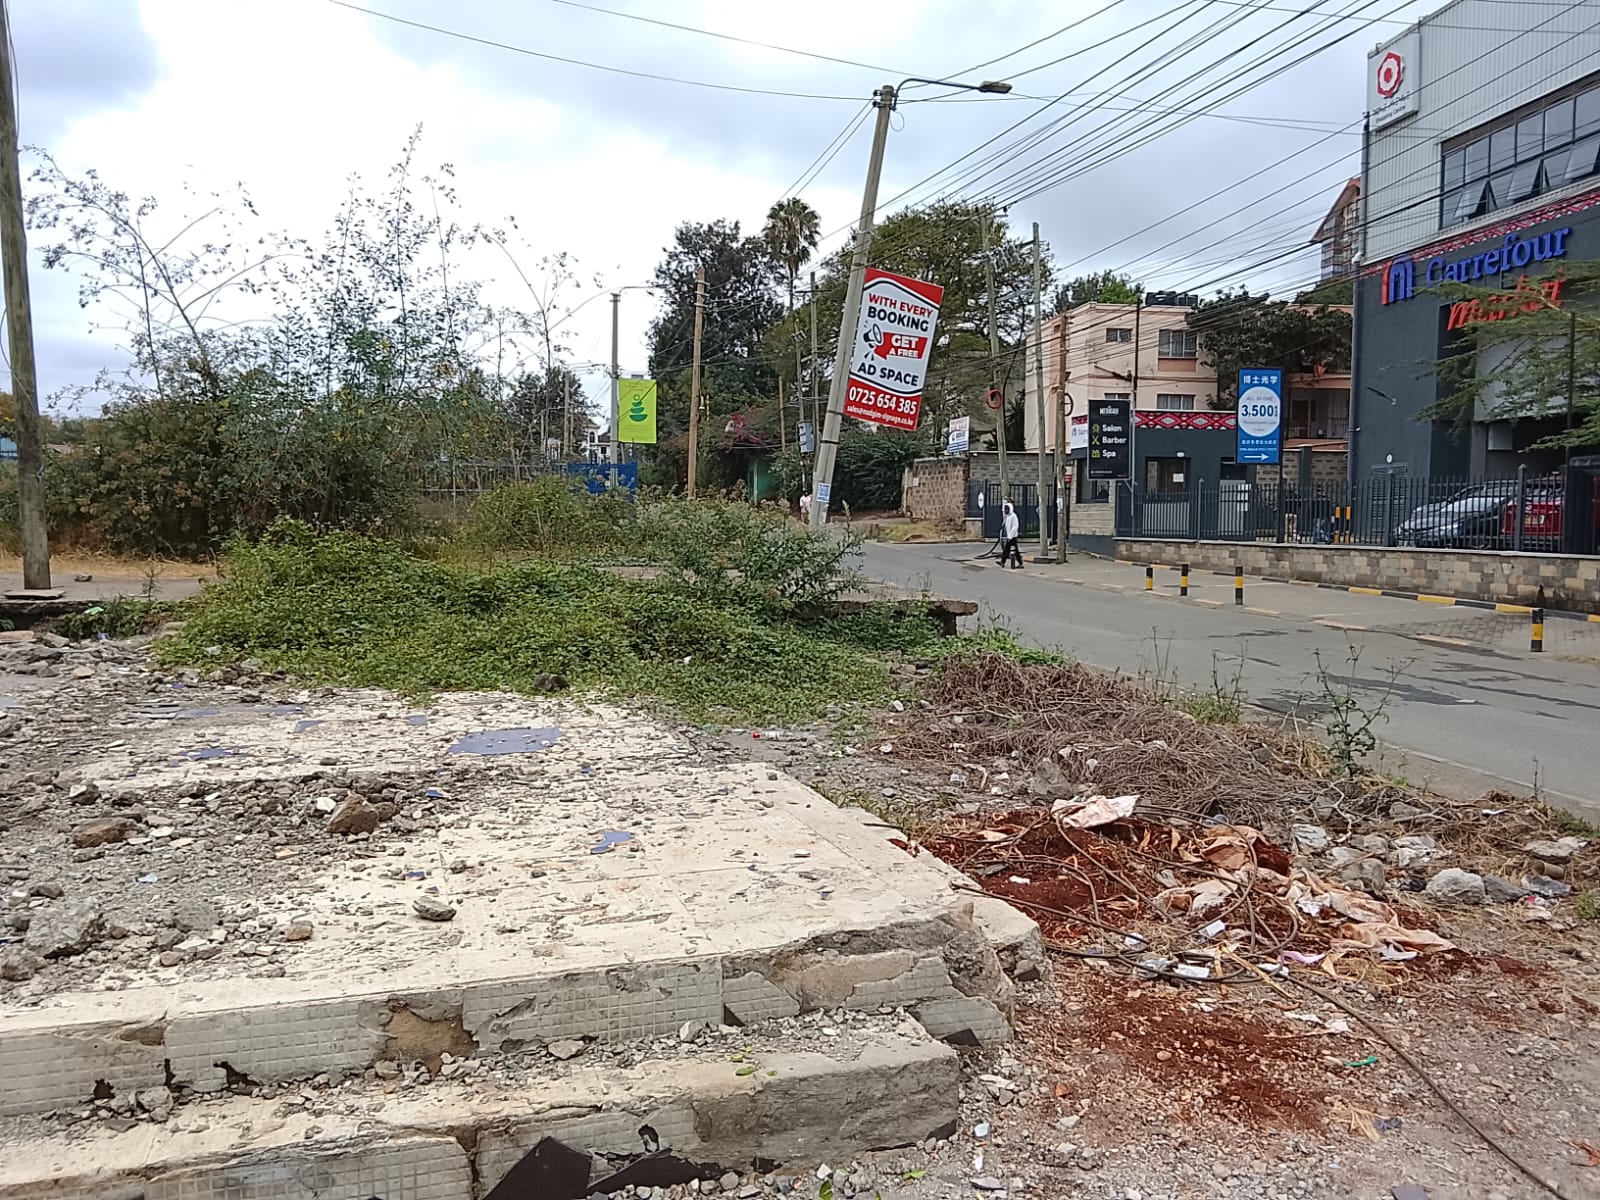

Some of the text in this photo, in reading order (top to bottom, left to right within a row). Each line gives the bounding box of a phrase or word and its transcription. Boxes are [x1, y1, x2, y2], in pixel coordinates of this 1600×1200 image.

[1425, 226, 1570, 288] Carrefour
[868, 292, 933, 318] WITH EVERY
[867, 306, 929, 332] BOOKING
[891, 334, 919, 349] GET
[889, 347, 919, 358] A FREE
[857, 362, 919, 387] AD SPACE
[849, 386, 917, 415] 0725 654 385
[1102, 423, 1122, 432] Salon
[1102, 436, 1127, 444] Barber
[1102, 449, 1117, 459] Spa
